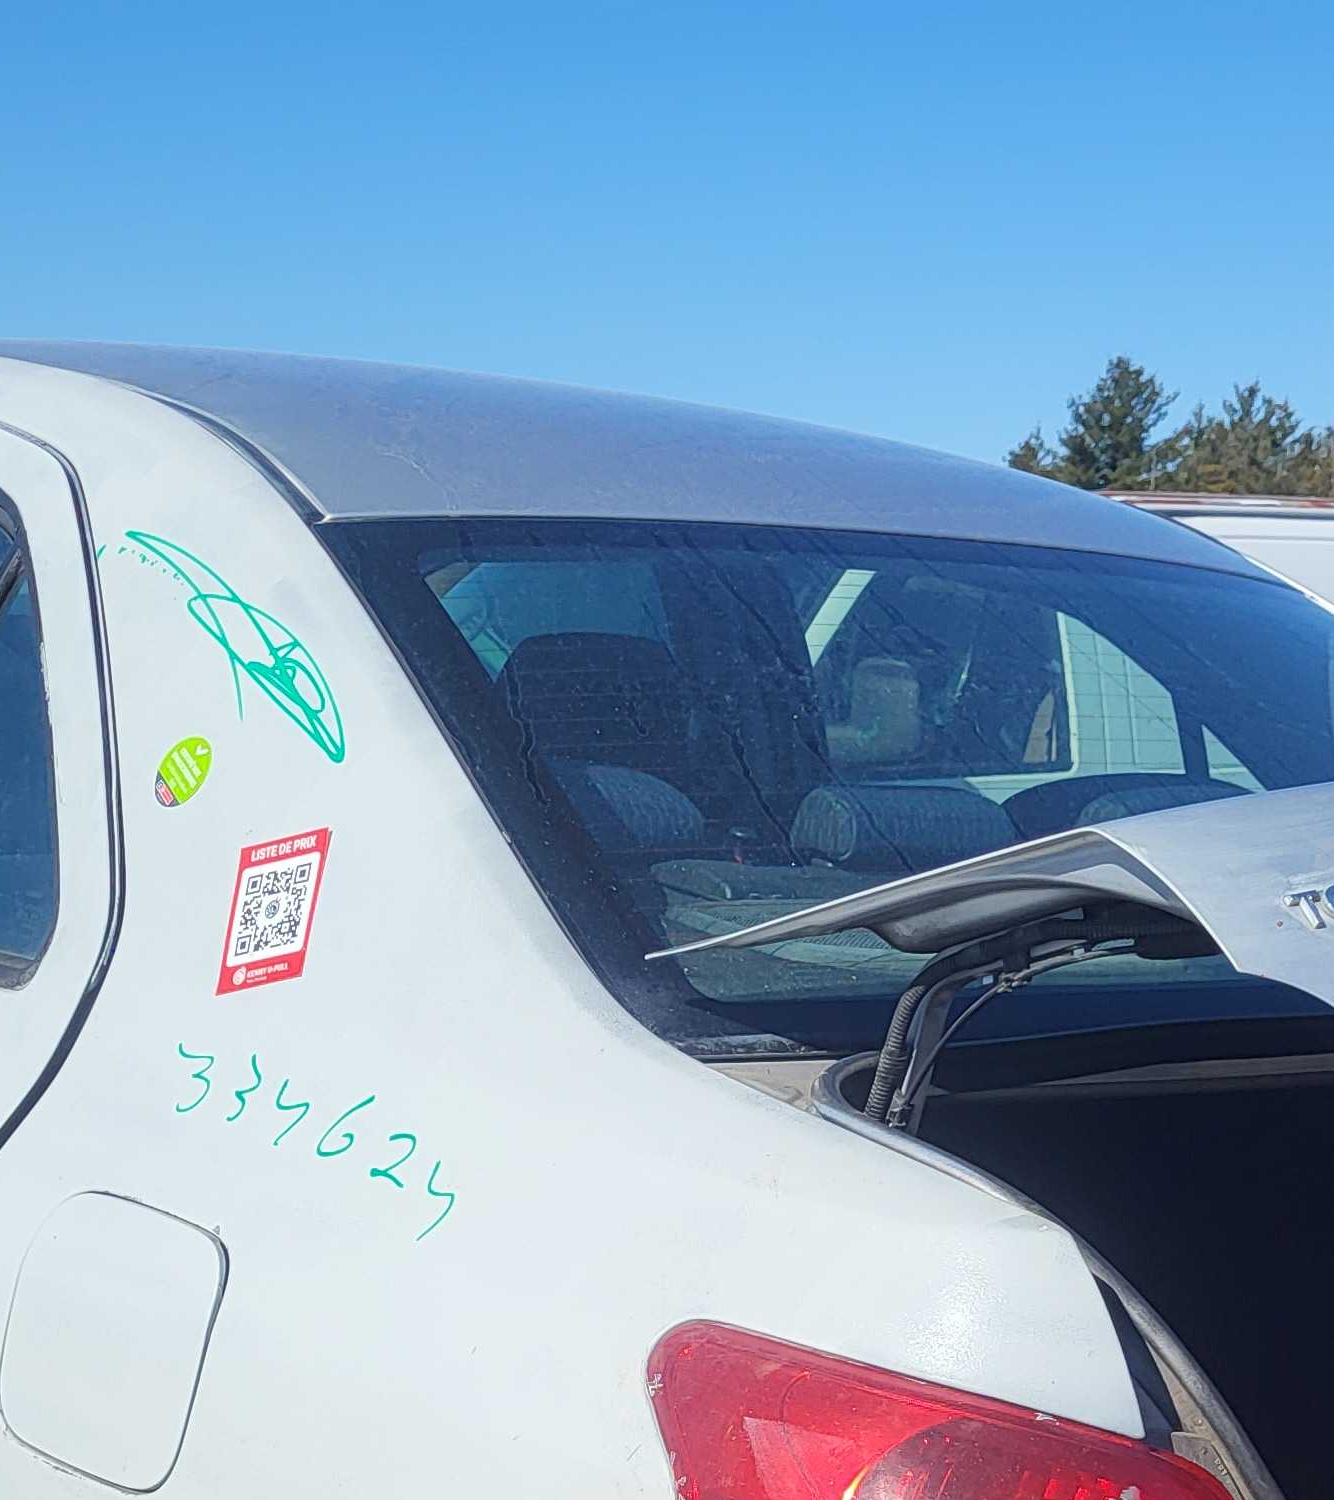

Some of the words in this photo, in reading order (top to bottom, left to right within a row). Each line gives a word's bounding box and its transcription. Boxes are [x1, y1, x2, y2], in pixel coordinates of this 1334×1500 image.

[250, 844, 278, 862] LISTE
[278, 840, 293, 856] DE
[293, 834, 318, 852] PRIX
[174, 1042, 456, 1241] 334624
